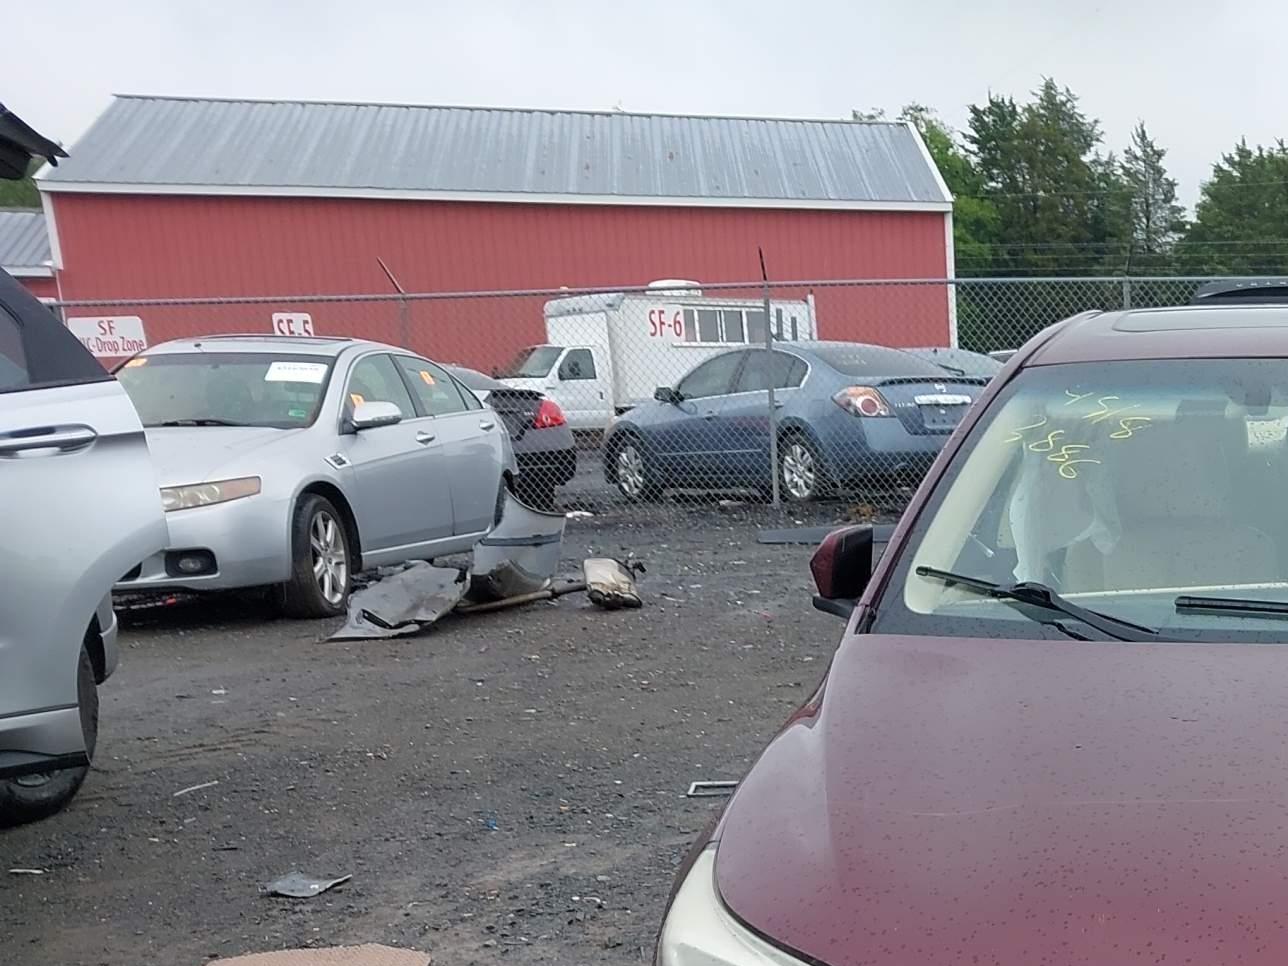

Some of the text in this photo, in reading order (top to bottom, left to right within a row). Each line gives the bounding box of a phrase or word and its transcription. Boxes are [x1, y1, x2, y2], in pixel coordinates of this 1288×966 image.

[97, 320, 115, 336] SF
[649, 309, 682, 337] SF-6
[120, 336, 145, 352] Zone
